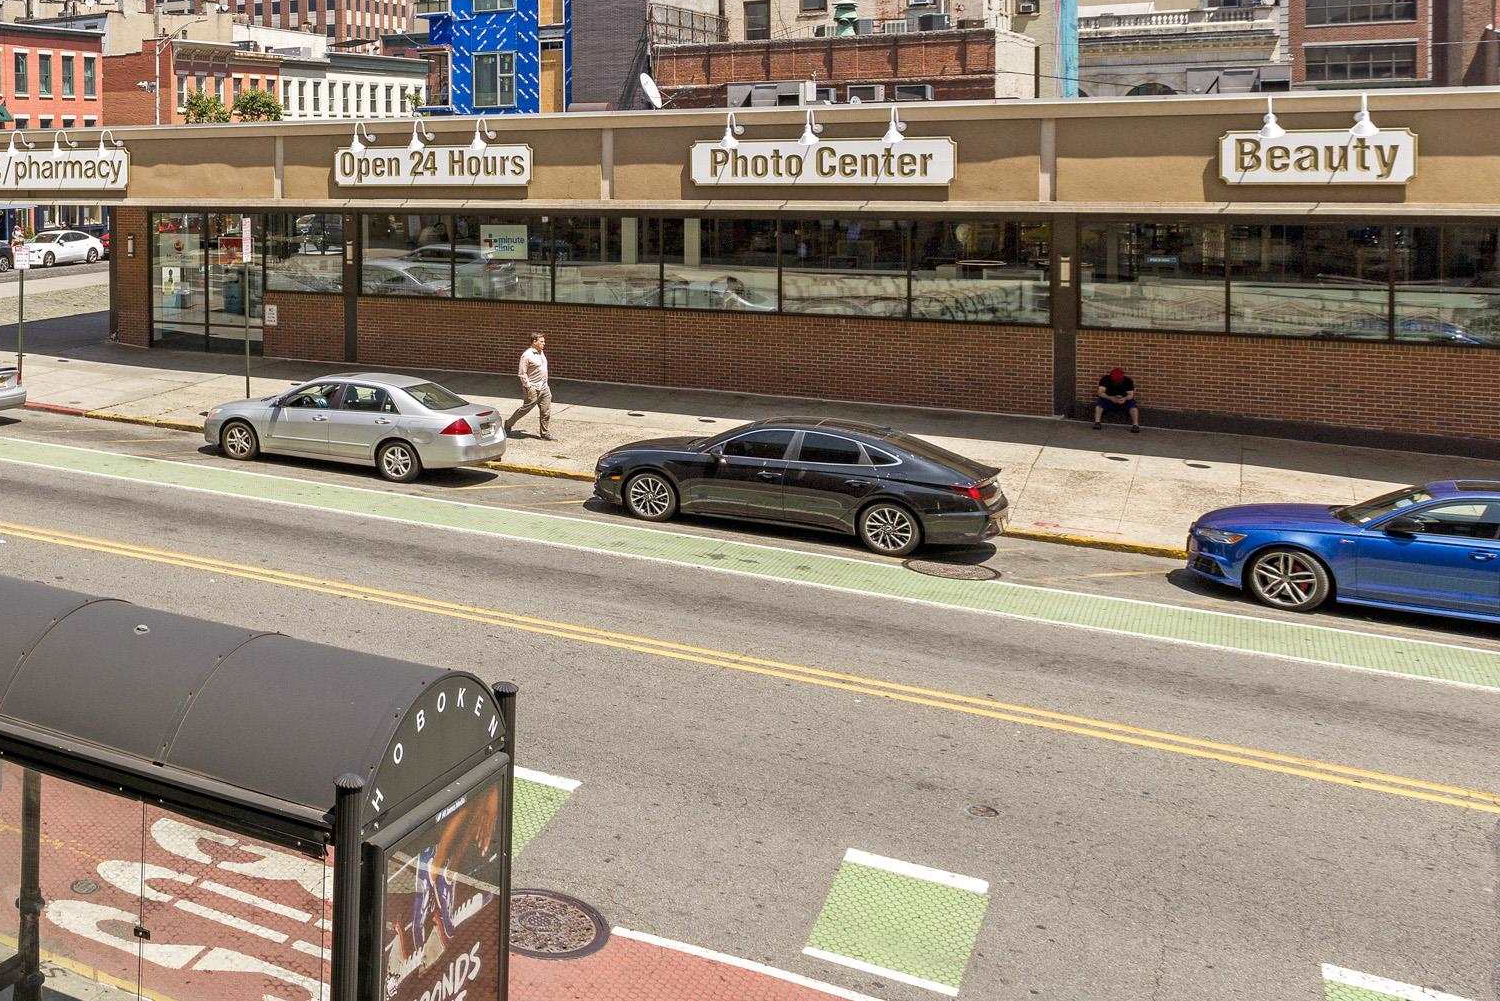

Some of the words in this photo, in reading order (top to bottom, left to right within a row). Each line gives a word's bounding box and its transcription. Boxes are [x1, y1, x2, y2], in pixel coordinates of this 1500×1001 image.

[340, 151, 401, 183] Open
[409, 150, 438, 177] 24
[448, 149, 525, 177] Hours
[710, 148, 804, 178] Photo
[815, 146, 933, 178] Center
[1234, 137, 1400, 179] Beauty
[495, 244, 515, 252] clinic
[498, 236, 525, 244] minute
[370, 687, 500, 814] HOBOKEN
